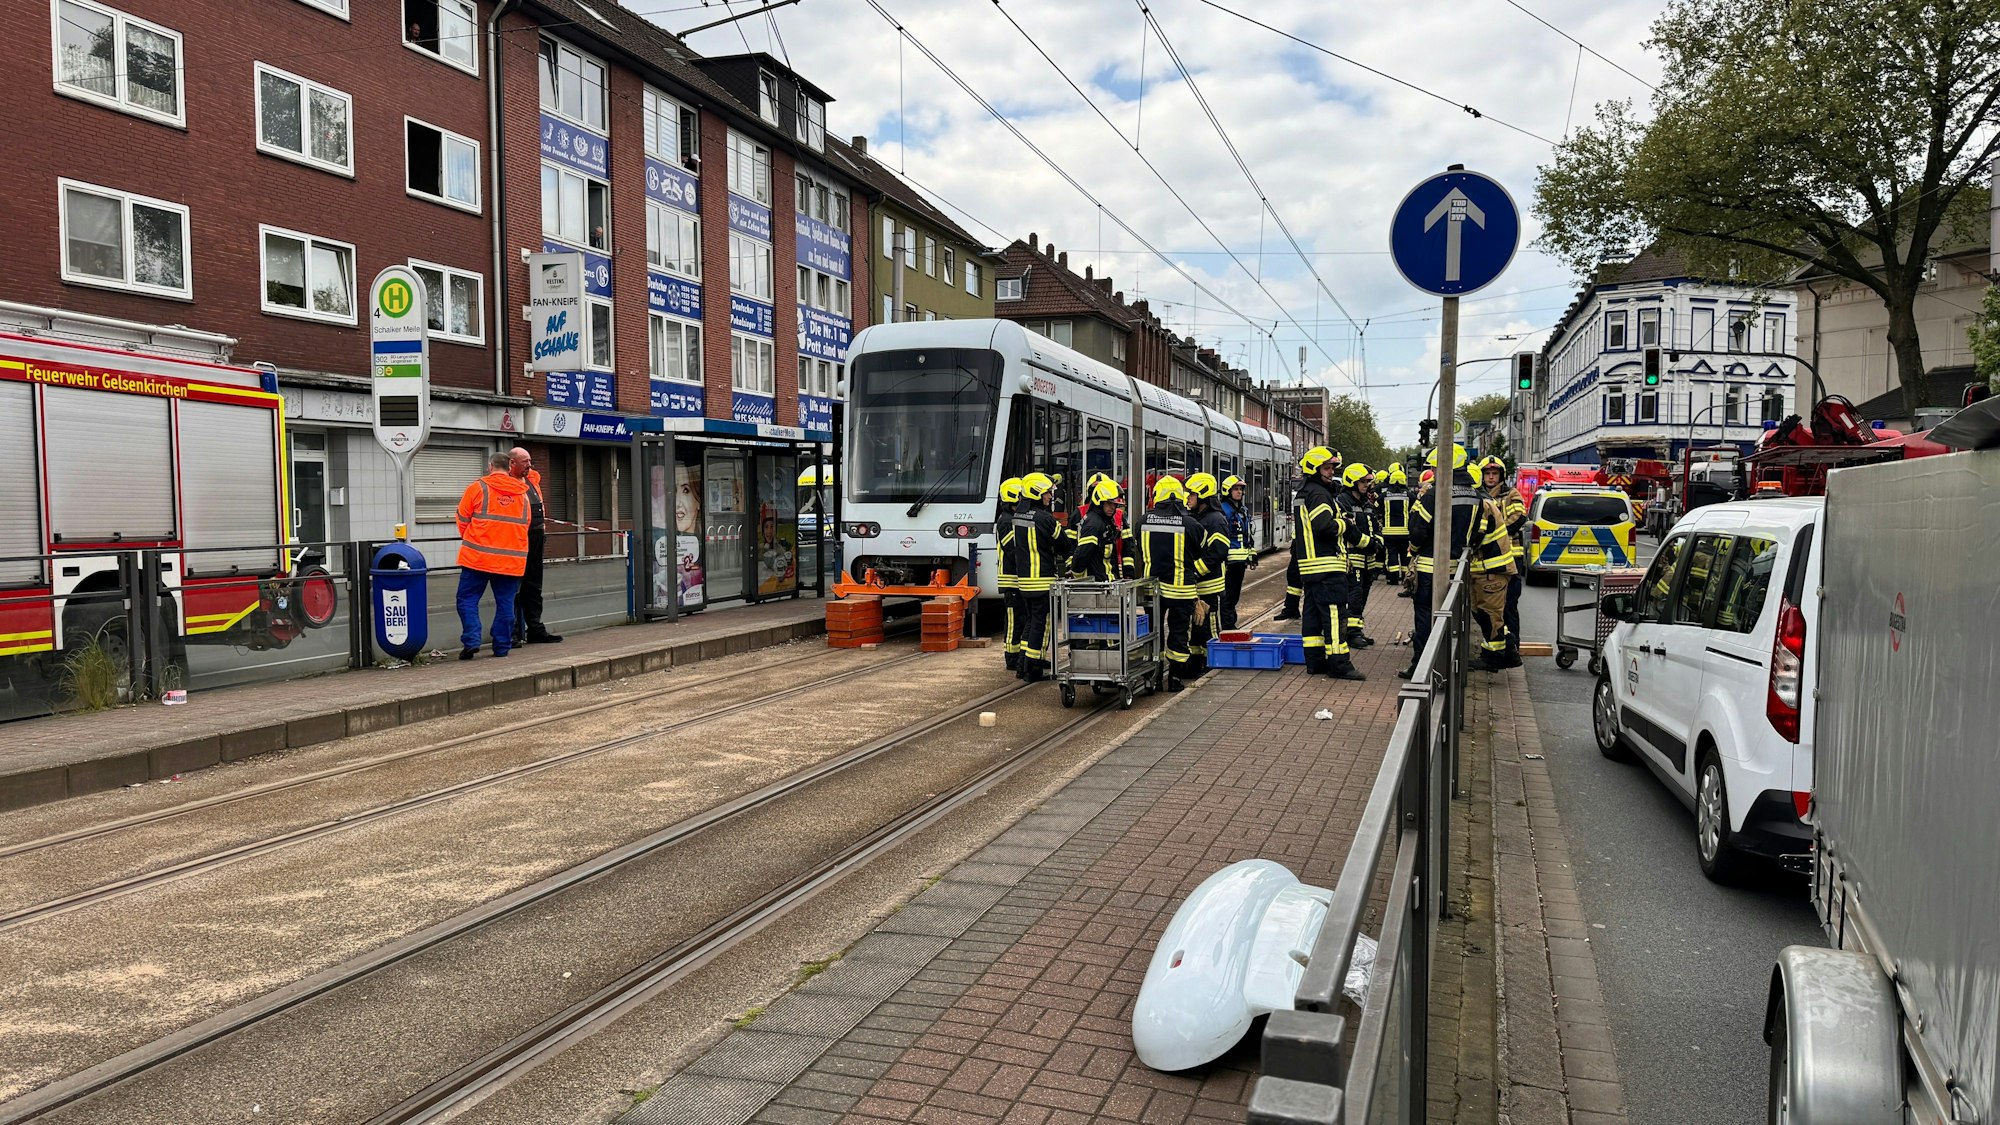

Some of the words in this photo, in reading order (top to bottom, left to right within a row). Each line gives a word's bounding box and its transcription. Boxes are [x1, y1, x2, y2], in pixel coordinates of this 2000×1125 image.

[741, 205, 750, 217] Blau
[751, 211, 759, 220] und
[747, 220, 760, 232] Leben
[389, 288, 403, 309] H
[533, 297, 578, 306] FAN-KNEIPE
[374, 308, 380, 318] 4
[732, 300, 754, 314] Deutscher
[546, 310, 566, 336] AUF
[810, 320, 821, 336] Die
[840, 329, 847, 343] im
[535, 332, 578, 360] SCHALKE
[807, 338, 821, 354] Pott
[823, 342, 836, 357] sind
[25, 363, 99, 387] Feuerwehr
[102, 373, 188, 397] Gelsenkirchen
[1034, 377, 1056, 396] BOGESTRA
[819, 401, 828, 414] sind
[741, 414, 747, 422] FC
[748, 414, 765, 424] Schalke
[583, 424, 614, 433] FAN-KNEIPE
[386, 606, 405, 616] SAU
[386, 617, 406, 626] BER!
